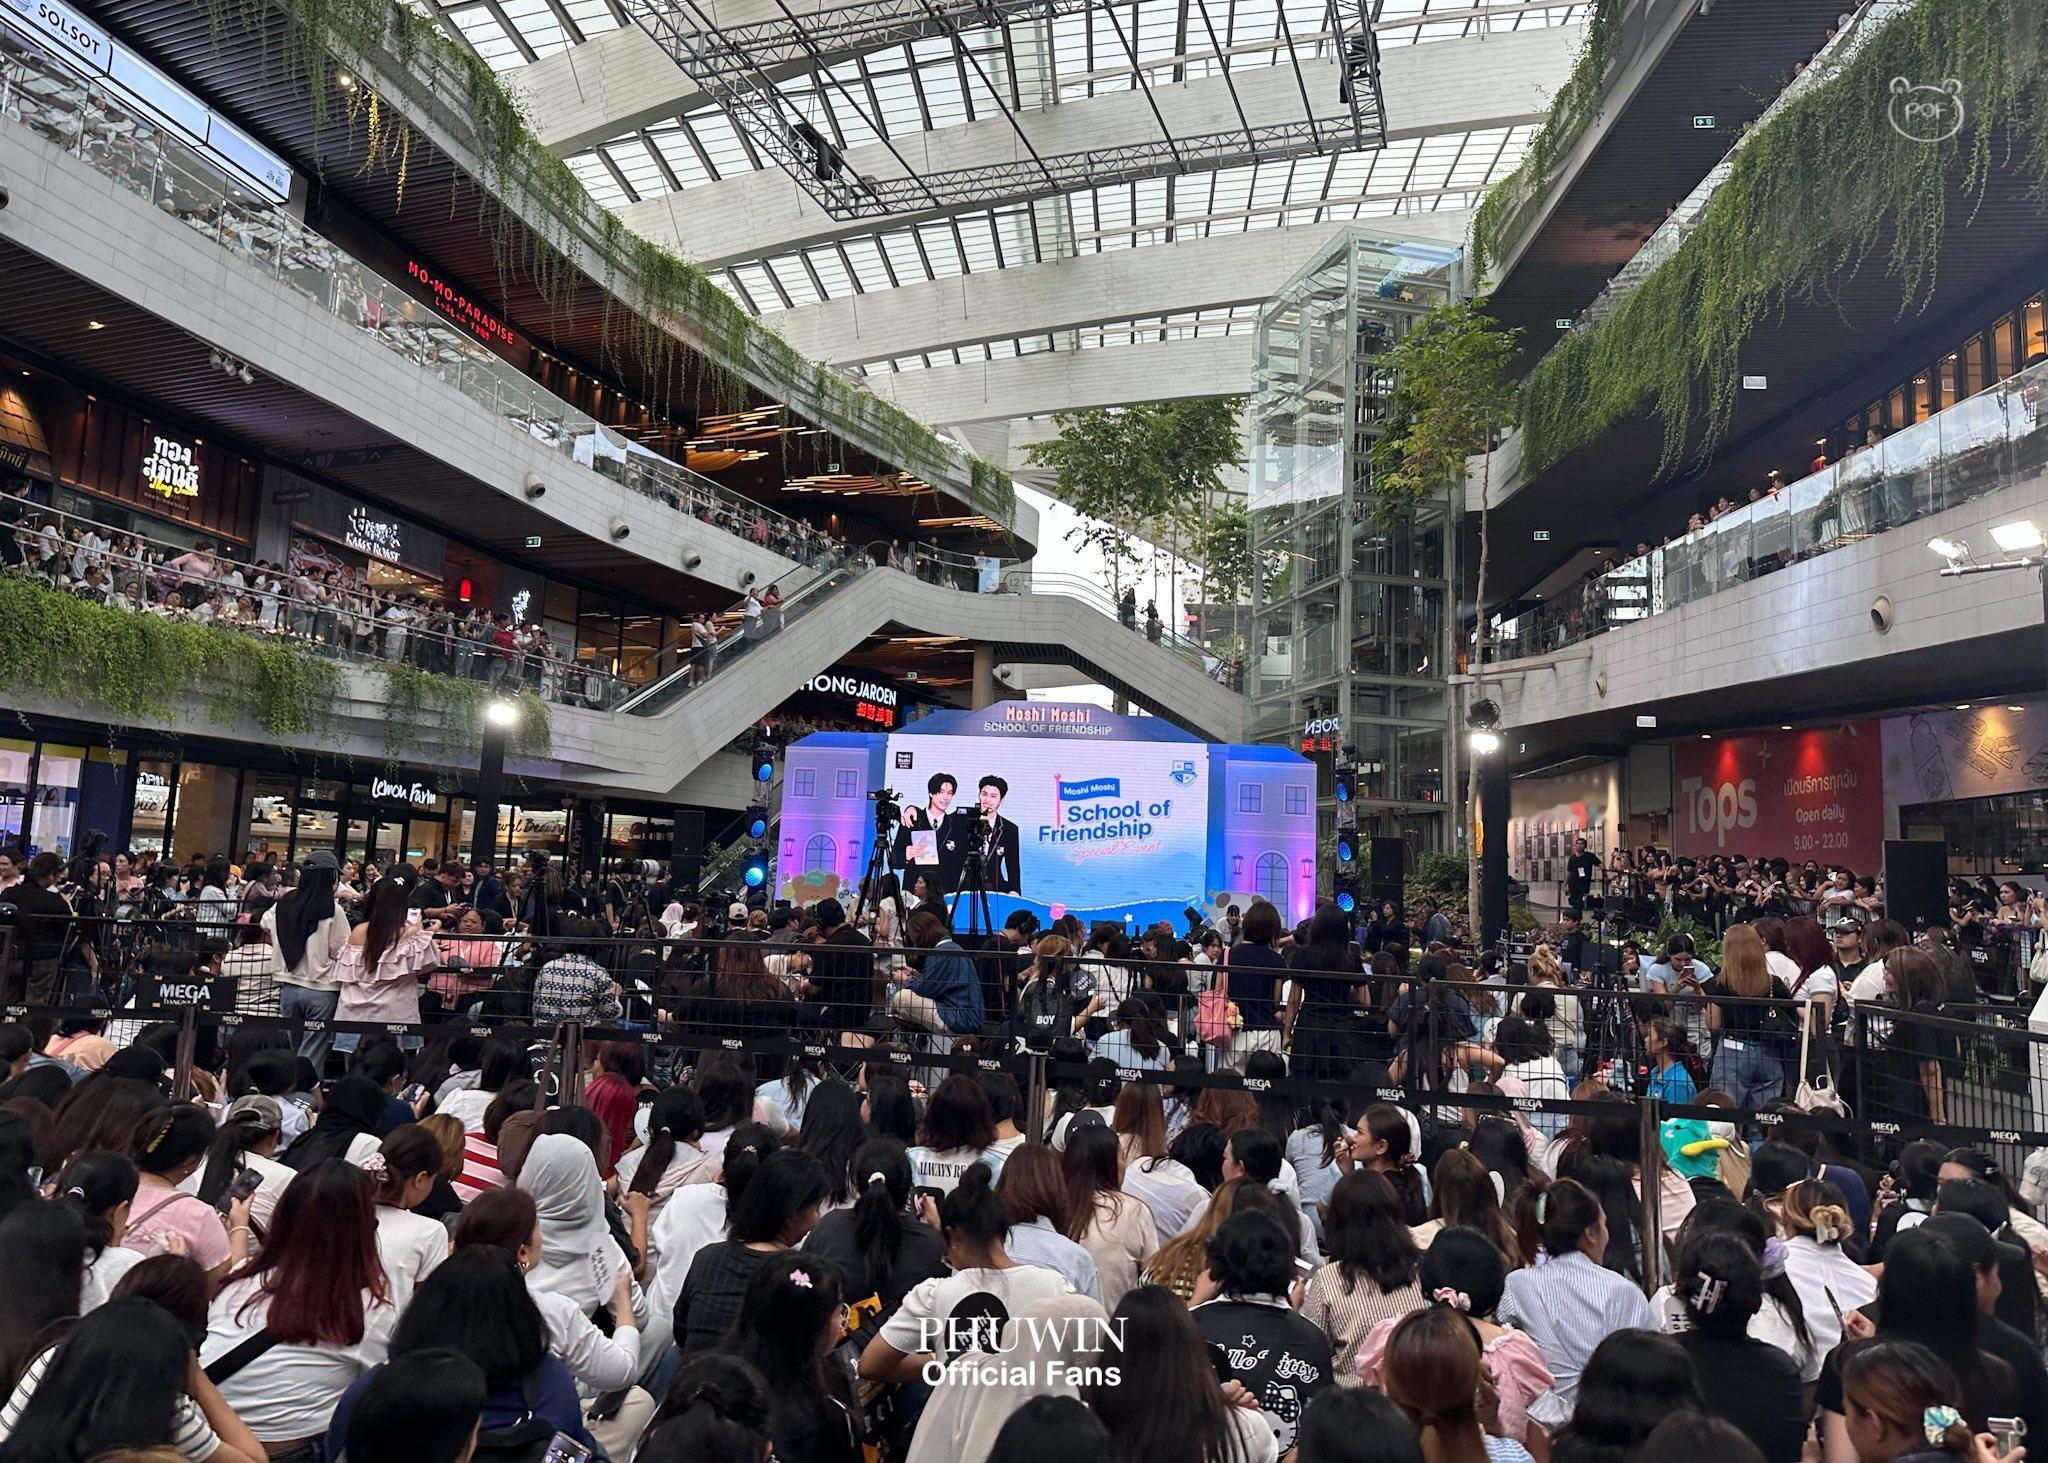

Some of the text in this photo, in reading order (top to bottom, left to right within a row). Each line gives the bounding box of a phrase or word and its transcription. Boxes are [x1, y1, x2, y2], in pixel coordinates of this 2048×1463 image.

[39, 3, 100, 55] SOLSOT
[408, 261, 514, 345] MO-MO-PARADISE
[154, 436, 192, 466] ทอง
[1010, 578, 1020, 586] L2
[1006, 706, 1090, 723] Moshi Moshi
[984, 722, 1112, 735] SCHOOL OF FRIENDSHIP
[1784, 769, 1858, 796] เปิดบริการทุกวัน
[372, 777, 436, 804] Lemon Farm
[1064, 784, 1115, 795] Moshi Moshi
[1068, 800, 1171, 822] School of
[1682, 776, 1757, 848] Tops
[1796, 803, 1845, 826] Open daily
[1040, 819, 1152, 842] Friendship
[1793, 835, 1813, 850] 9.00
[1822, 832, 1848, 849] 22.00
[1067, 840, 1161, 866] Special Event
[1971, 950, 1989, 964] MEGA
[160, 984, 211, 1004] MEGA
[222, 1015, 243, 1025] MEGA
[304, 1020, 325, 1030] MEGA
[1036, 1015, 1055, 1025] BOY
[387, 1024, 408, 1034] MEGA
[471, 1027, 492, 1036] MEGA
[642, 1032, 662, 1042] MEGA
[722, 1039, 743, 1049] MEGA
[804, 1045, 825, 1056] MEGA
[890, 1052, 911, 1063] MEGA
[978, 1059, 1001, 1070] MEGA
[1115, 1068, 1143, 1081] MEGA
[1243, 1078, 1271, 1091] MEGA
[1376, 1088, 1405, 1101] MEGA
[1513, 1098, 1543, 1111] MEGA
[1755, 1112, 1784, 1125] MEGA
[1871, 1122, 1900, 1134] MEGA
[1990, 1131, 2021, 1143] MEGA
[918, 1161, 952, 1177] ALWAYS
